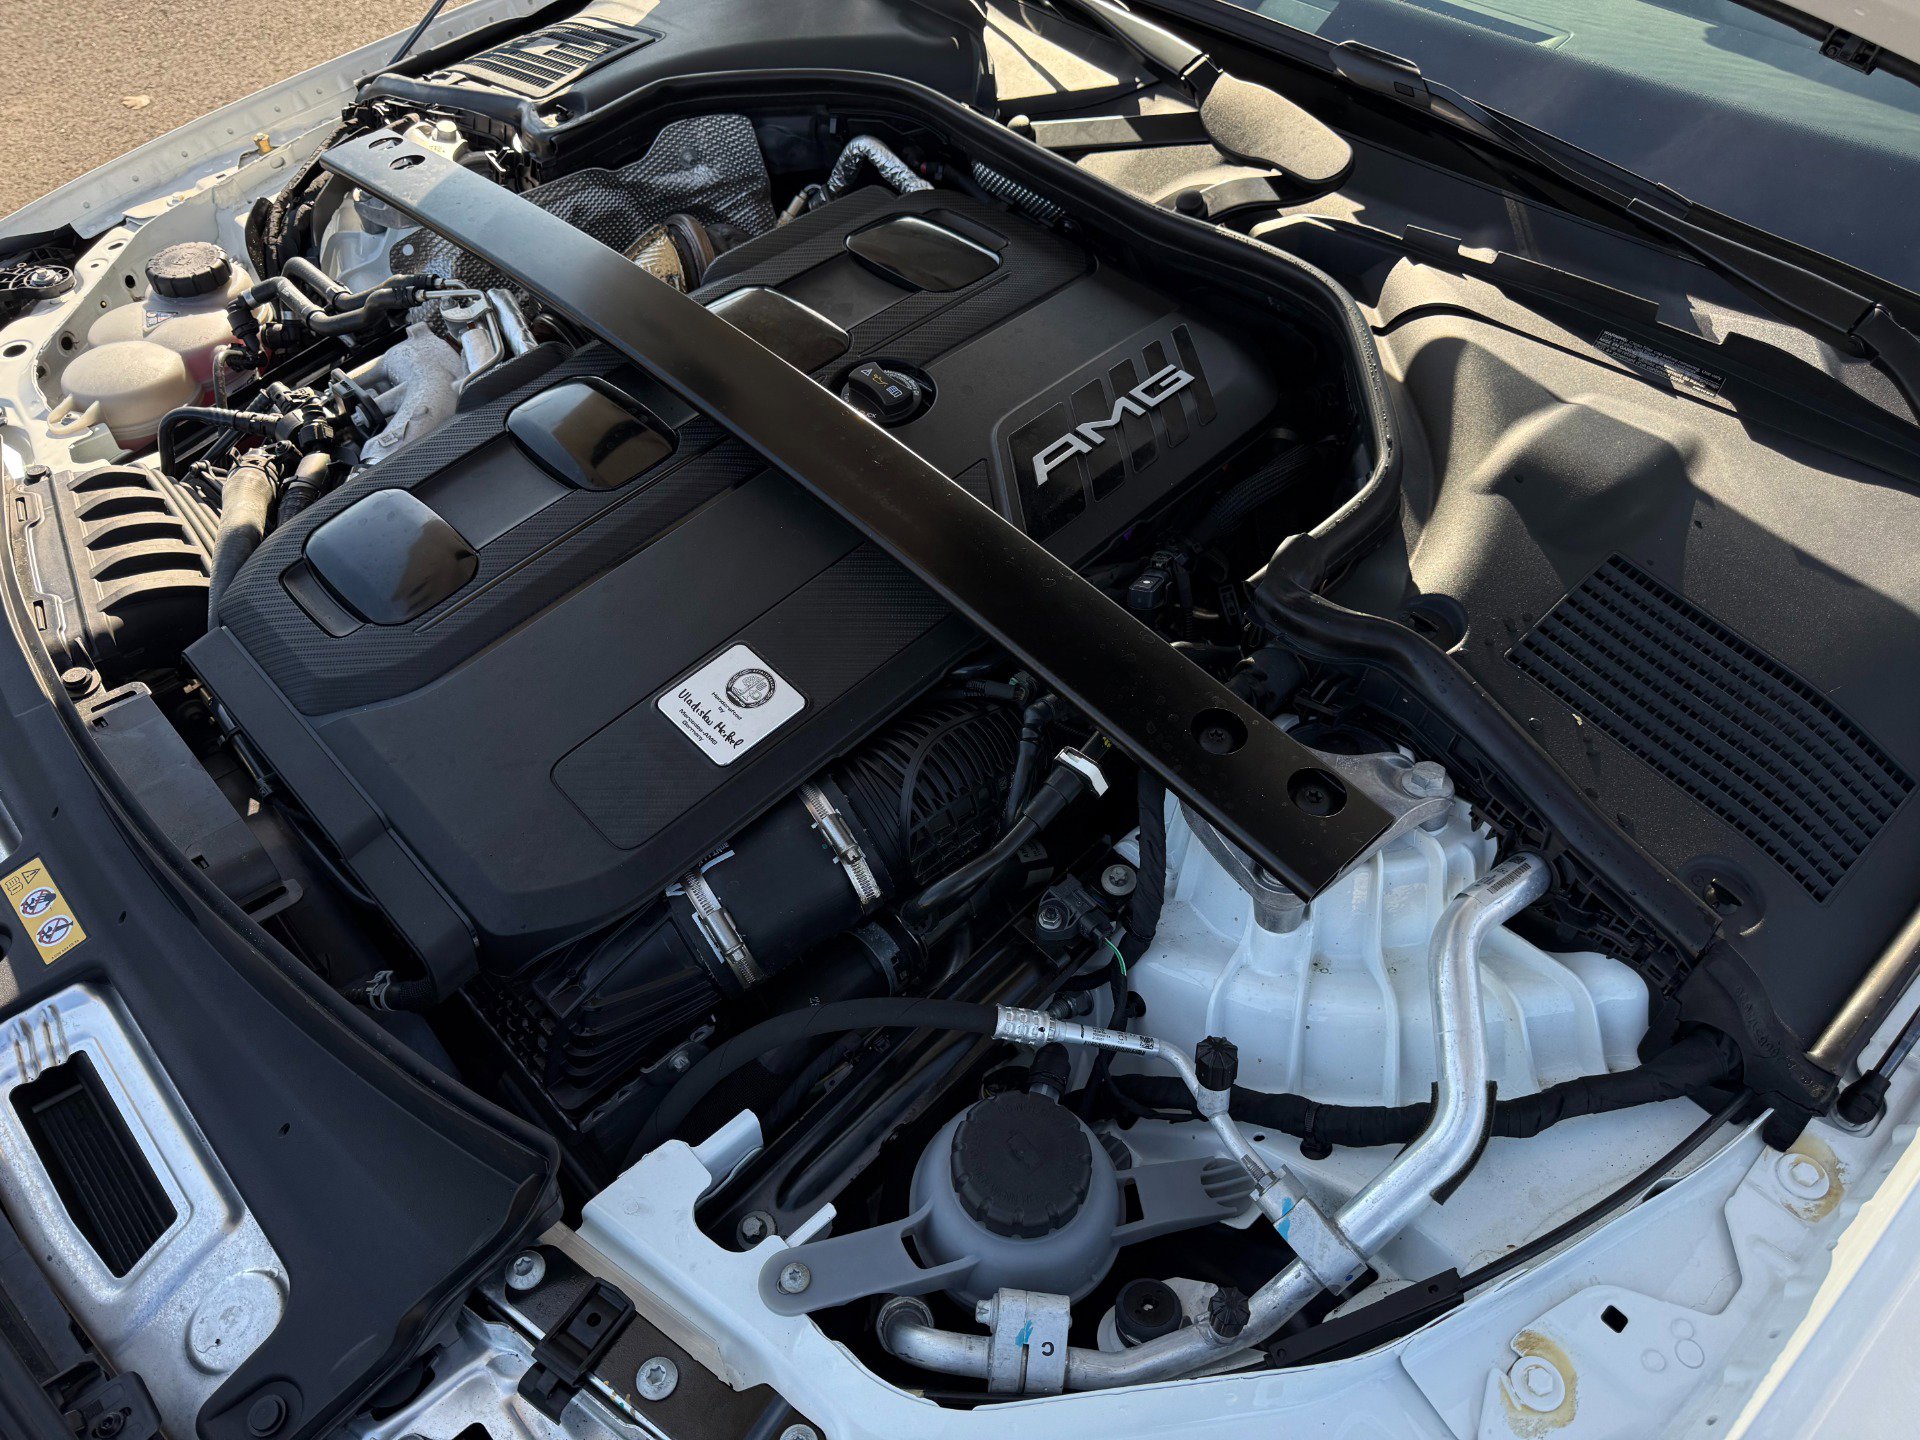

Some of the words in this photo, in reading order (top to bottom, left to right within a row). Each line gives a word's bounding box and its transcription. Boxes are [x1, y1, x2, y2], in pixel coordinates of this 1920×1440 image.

[1032, 363, 1195, 486] AMG
[711, 692, 743, 721] Handcrafted
[679, 708, 718, 746] Mercedes-AMG
[682, 720, 705, 742] Germany
